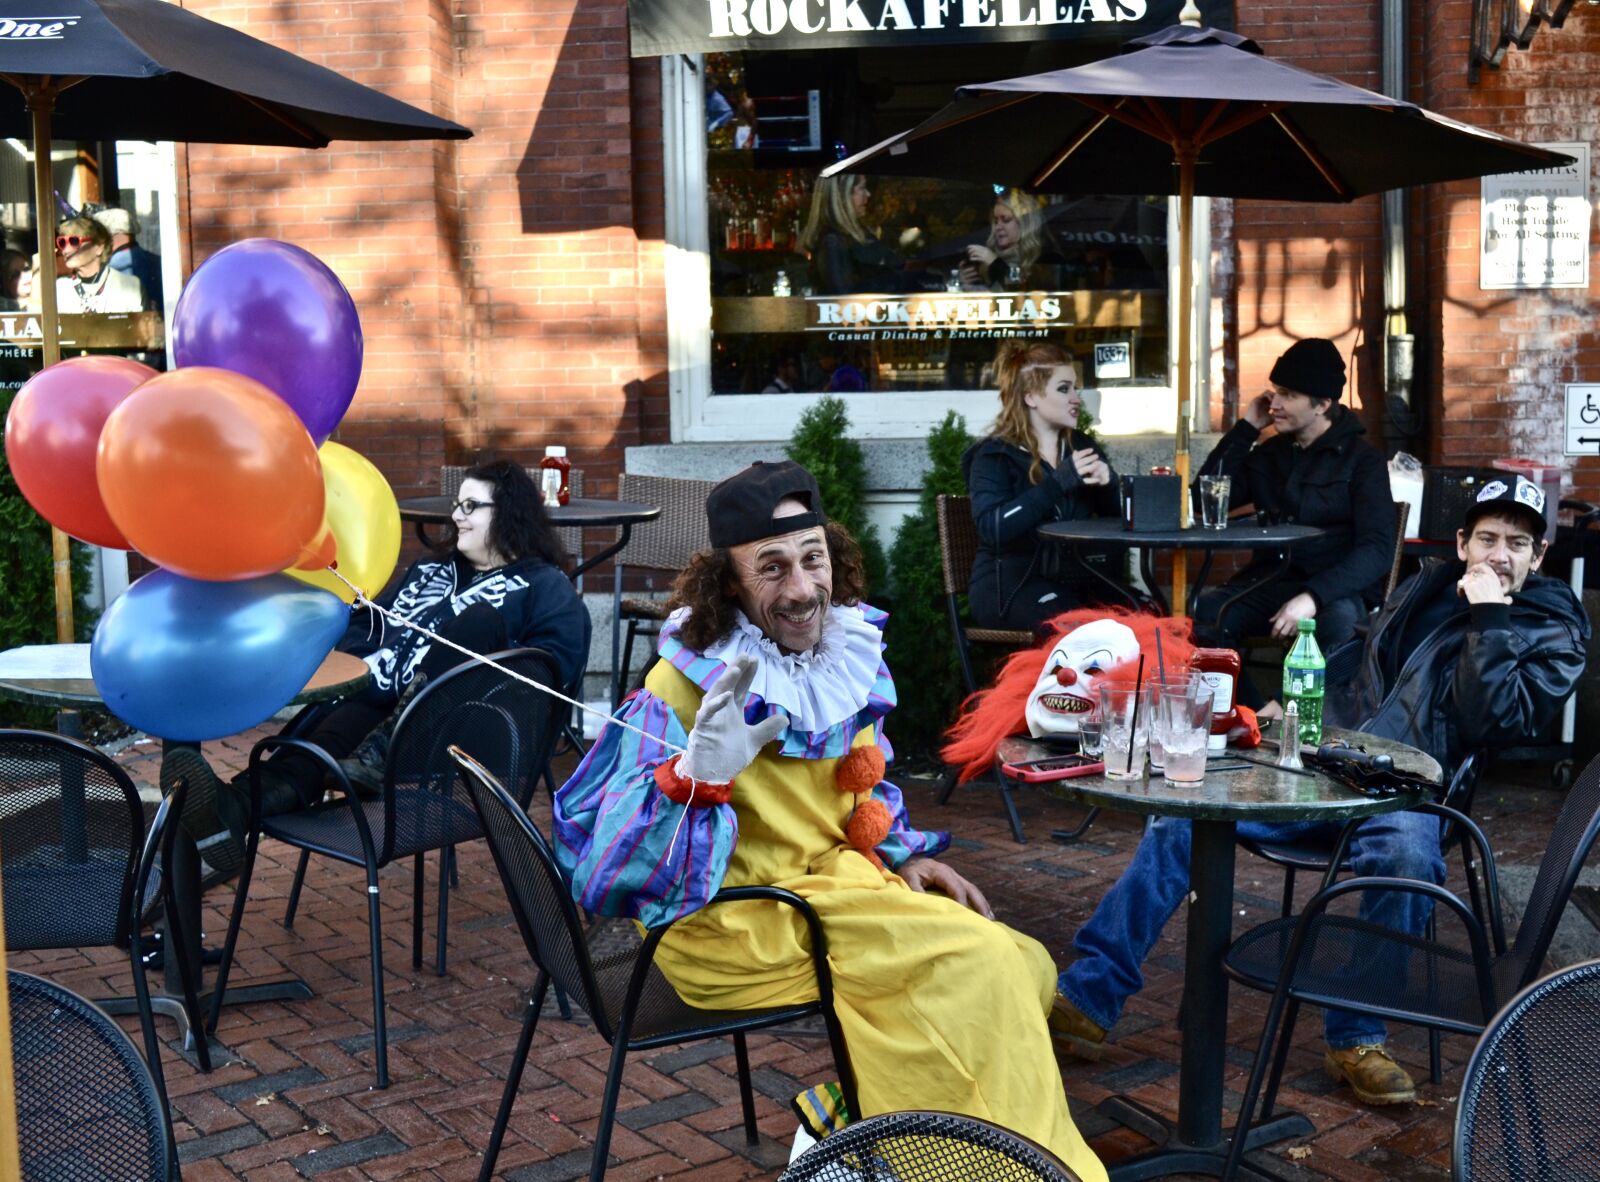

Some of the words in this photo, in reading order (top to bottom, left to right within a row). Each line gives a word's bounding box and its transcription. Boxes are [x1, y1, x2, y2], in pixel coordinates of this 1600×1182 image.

[708, 0, 1147, 37] ROCKAFELLAS
[817, 299, 1061, 323] ROCKAFELLAS
[828, 331, 876, 341] Casual
[882, 330, 928, 340] Dining
[933, 330, 943, 339] &
[949, 328, 1049, 339] Entertainment
[1098, 347, 1125, 361] 1637
